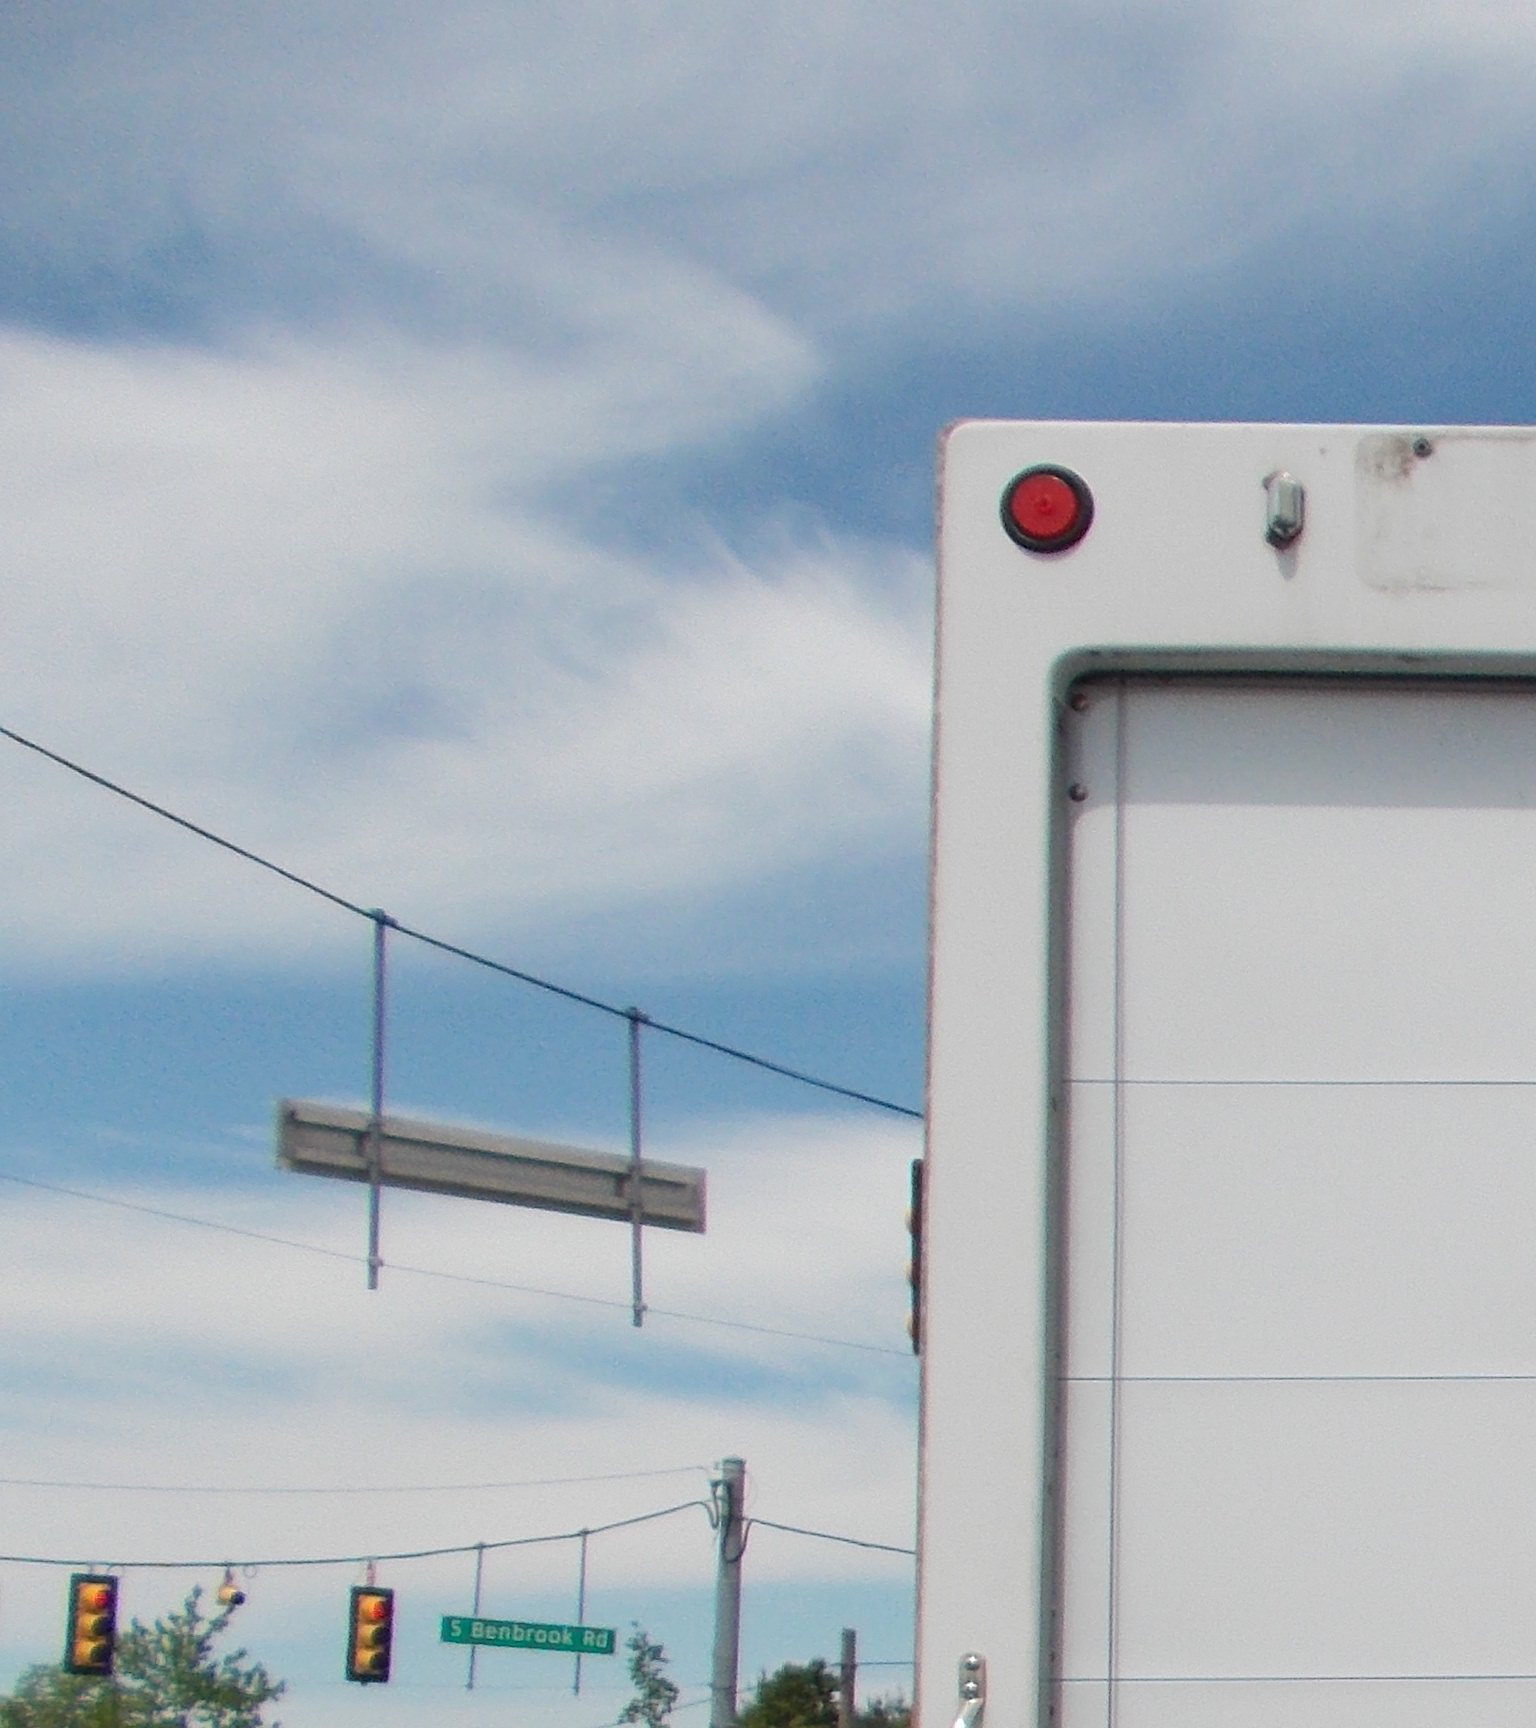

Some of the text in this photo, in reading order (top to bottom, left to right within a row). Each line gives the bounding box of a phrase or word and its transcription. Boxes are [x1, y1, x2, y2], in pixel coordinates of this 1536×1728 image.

[450, 1621, 608, 1648] S Benbrook Rd
